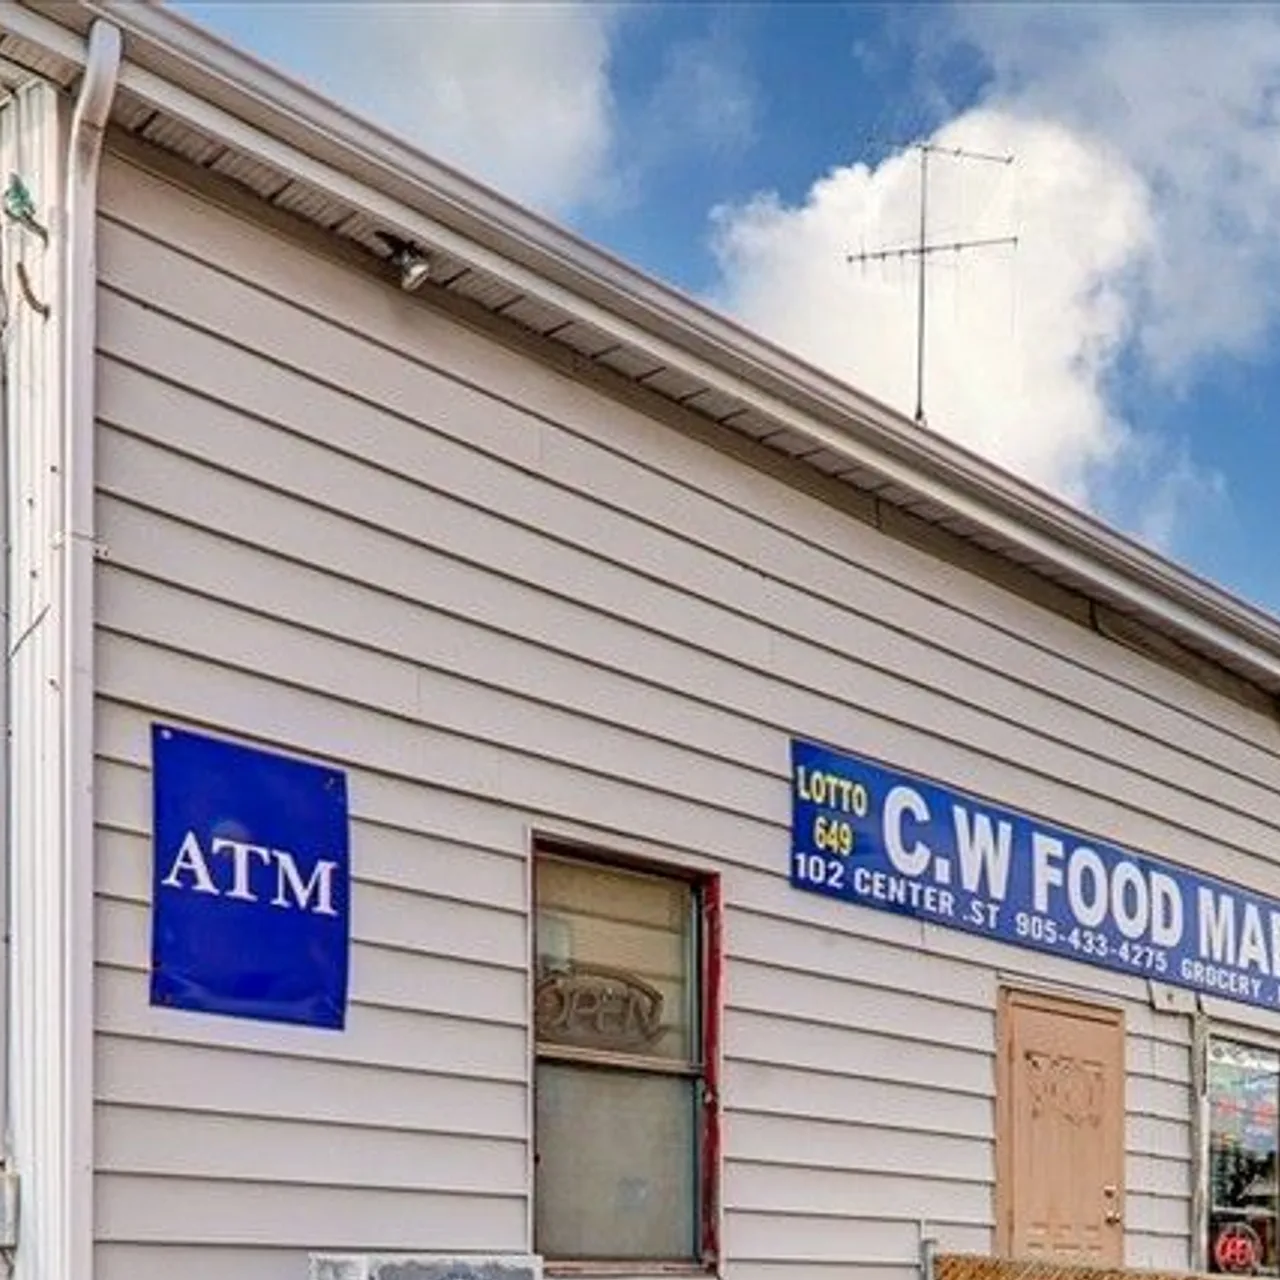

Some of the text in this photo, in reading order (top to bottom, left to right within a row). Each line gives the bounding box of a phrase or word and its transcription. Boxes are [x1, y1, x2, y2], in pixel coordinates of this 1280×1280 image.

[797, 765, 868, 818] LOTTO
[162, 830, 339, 917] ATM
[814, 815, 853, 857] 649
[883, 786, 1013, 901] C.W
[1031, 831, 1184, 948] FOOD
[794, 852, 845, 889] 102
[853, 866, 956, 917] CENTER
[1015, 911, 1169, 974] 905-433-4275
[1181, 957, 1263, 998] GROCERY
